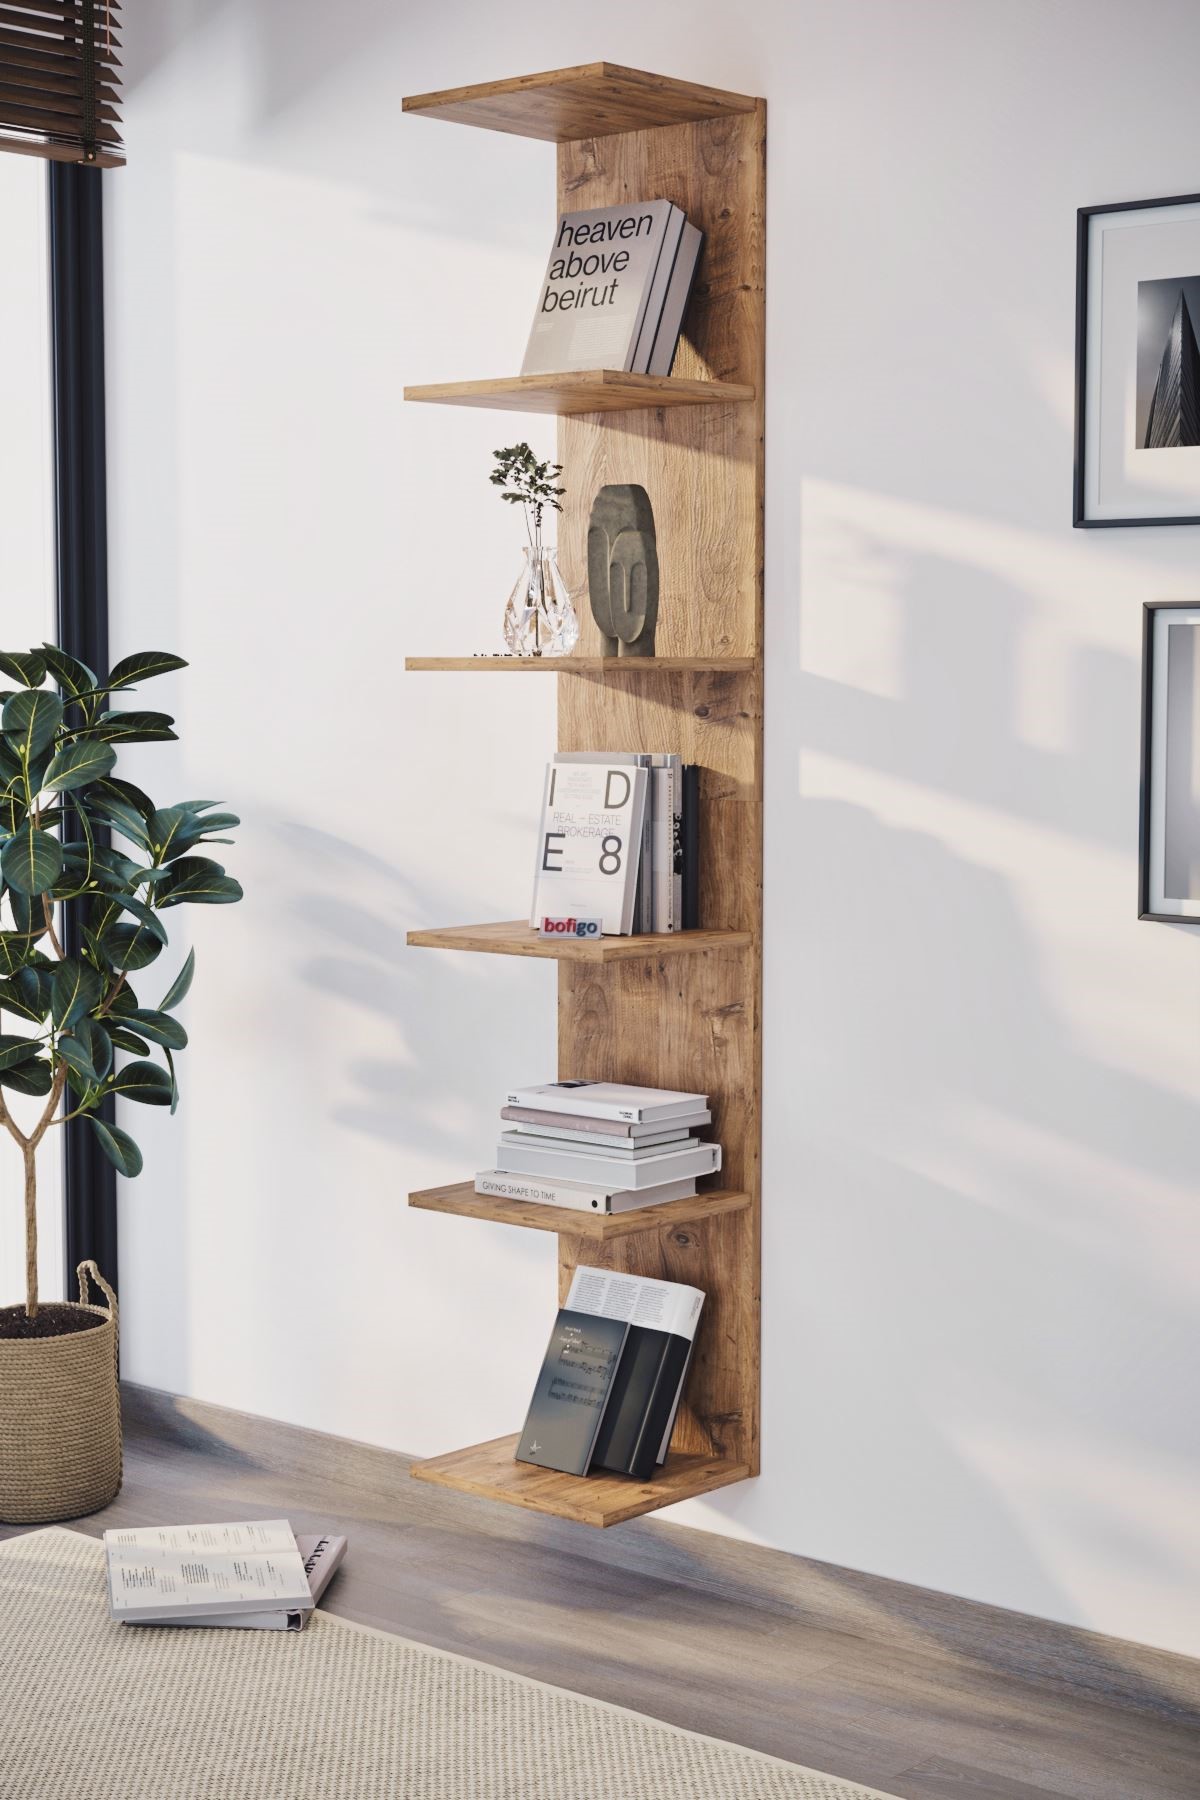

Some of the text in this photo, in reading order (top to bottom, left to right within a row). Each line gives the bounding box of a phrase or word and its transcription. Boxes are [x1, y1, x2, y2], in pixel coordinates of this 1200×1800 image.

[557, 214, 653, 248] heaven
[549, 250, 630, 281] above
[541, 278, 619, 313] beirut
[604, 770, 631, 809] D
[553, 812, 576, 823] REAL
[588, 813, 622, 825] ESTATE
[557, 826, 615, 838] BROKERAGE
[542, 832, 566, 872] E
[599, 835, 622, 875] 8
[544, 917, 598, 937] bofigo
[482, 1181, 556, 1201] GIVING SHAPE TO TIME
